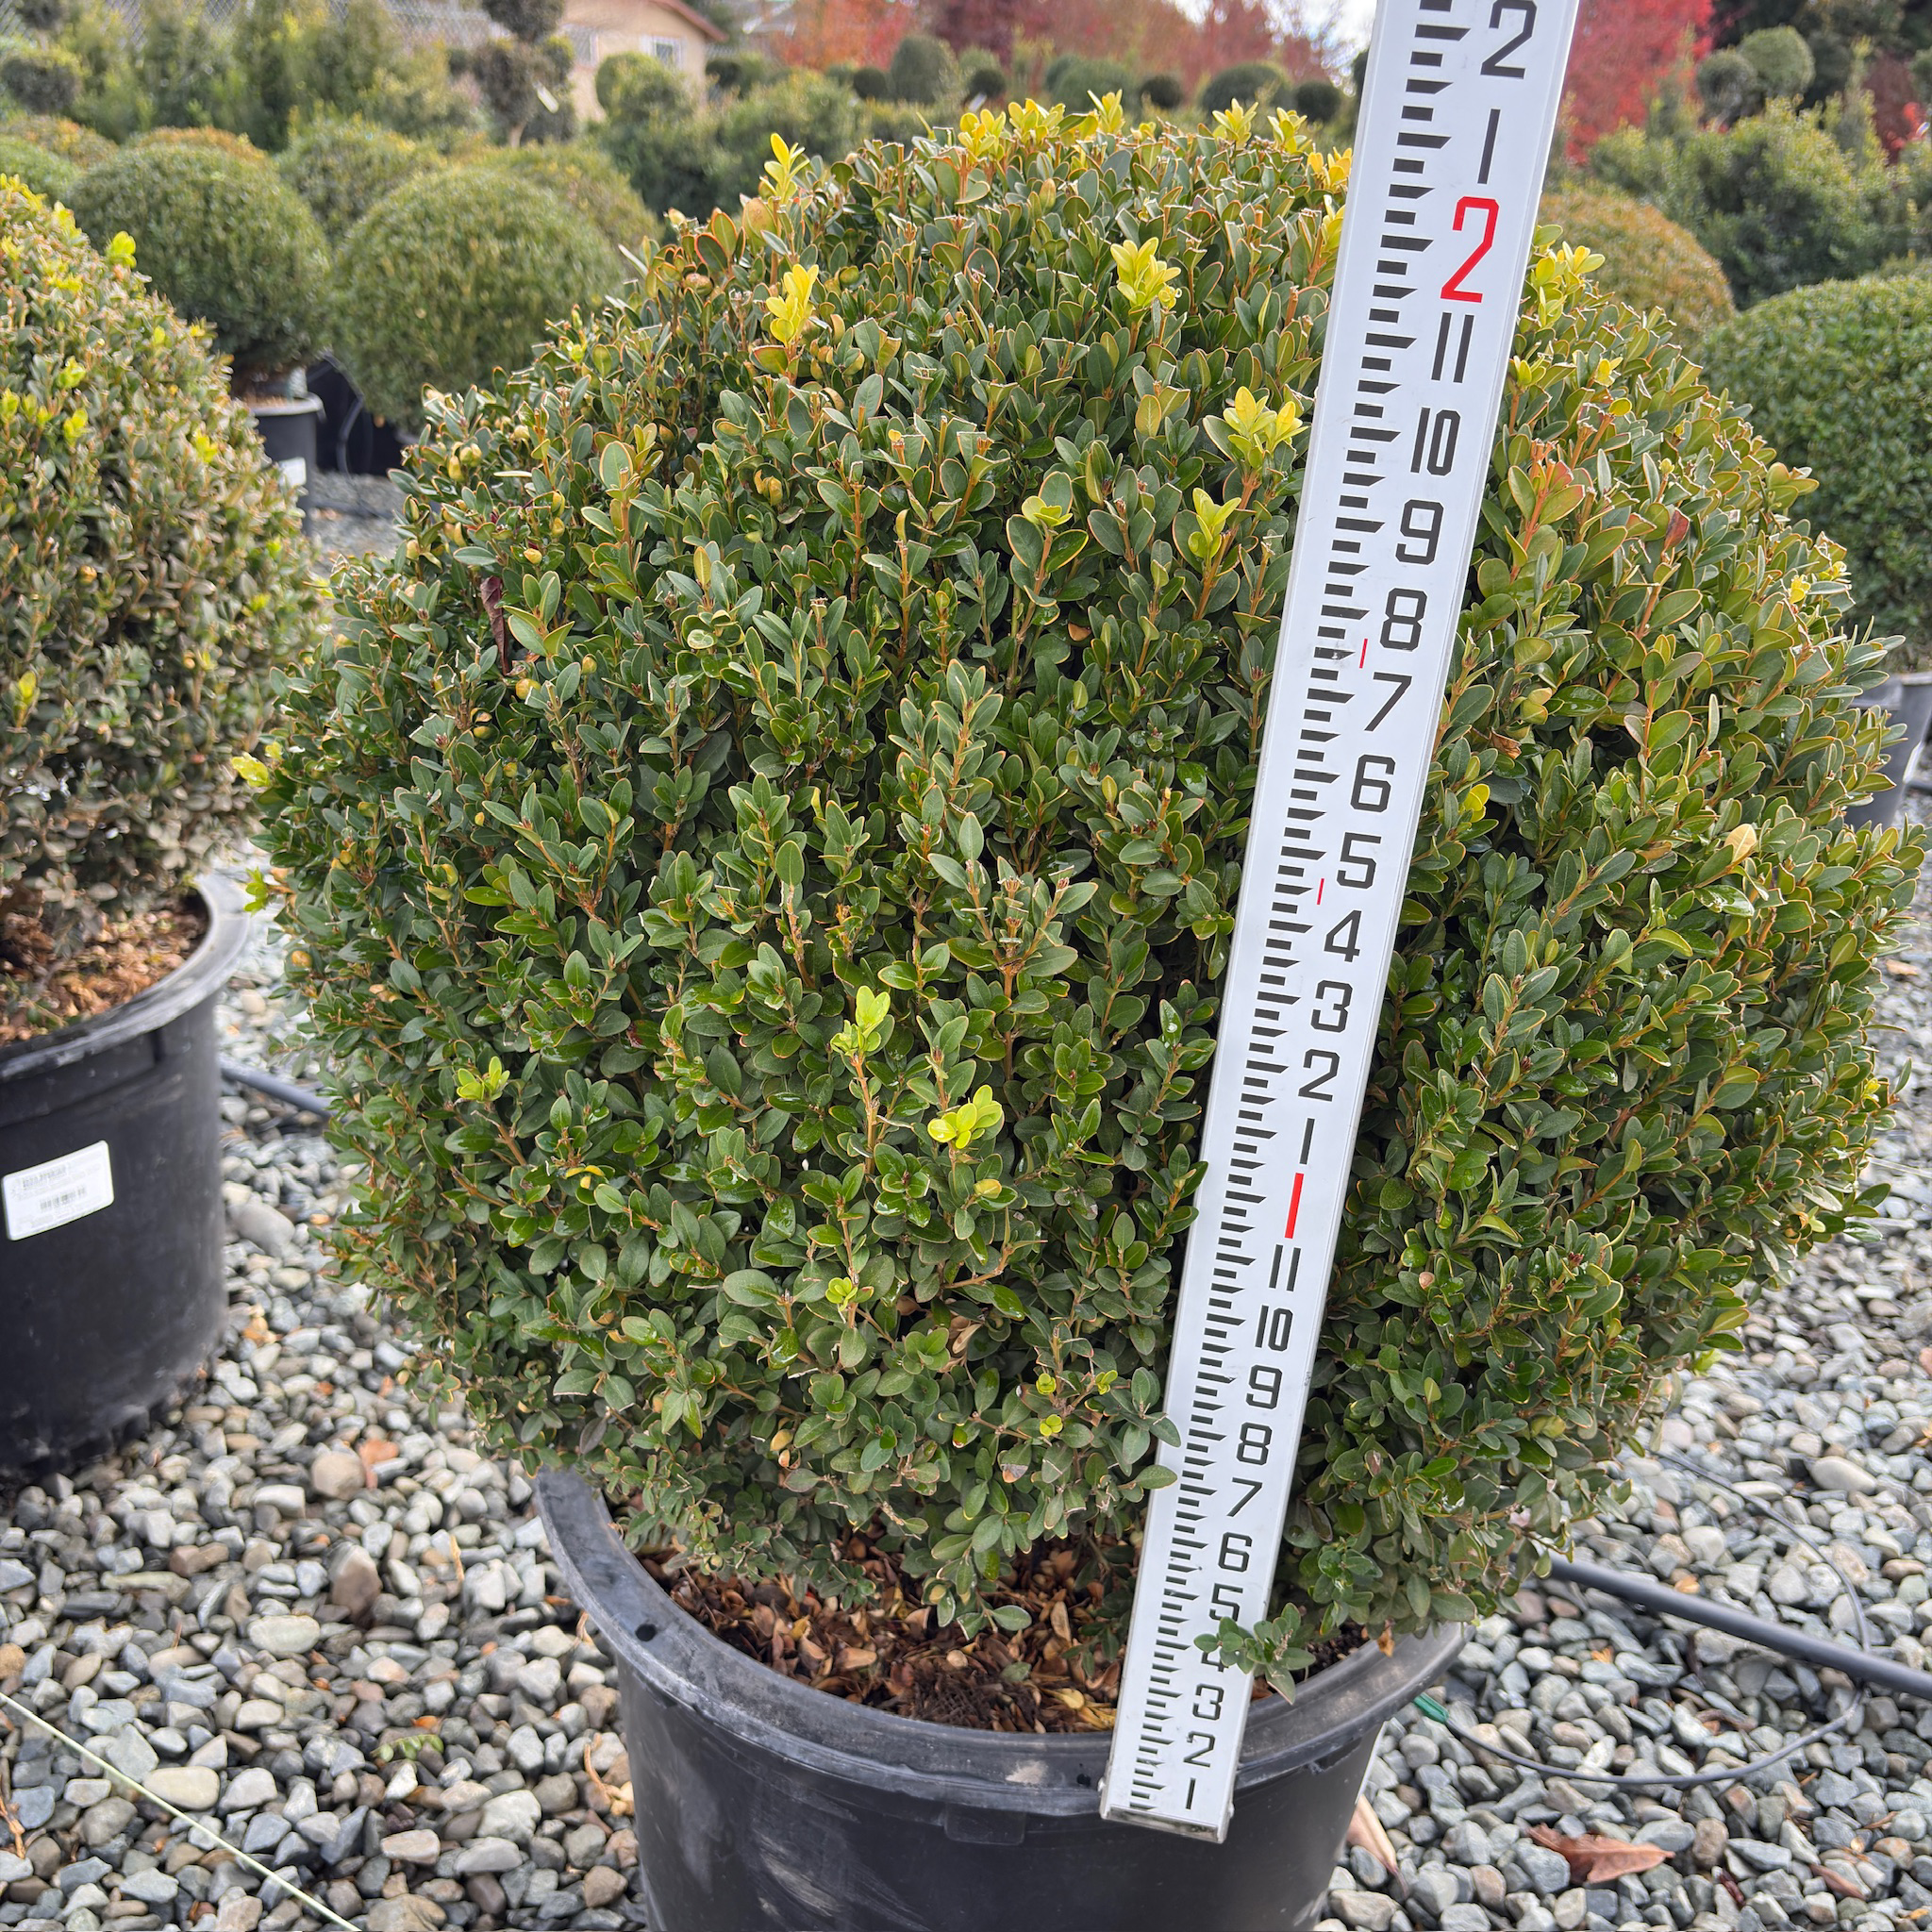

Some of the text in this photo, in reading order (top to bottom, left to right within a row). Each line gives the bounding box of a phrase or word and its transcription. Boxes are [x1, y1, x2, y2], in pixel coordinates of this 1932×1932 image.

[1481, 0, 1537, 79] 2
[1478, 108, 1500, 184] 1
[1441, 196, 1499, 303] 2
[1431, 312, 1474, 383] 11
[1411, 408, 1460, 475] 10
[1395, 500, 1444, 565] 9
[1379, 588, 1427, 651] 8
[1364, 672, 1412, 732] 7
[1350, 754, 1396, 813] 6
[1336, 832, 1382, 890] 5
[1324, 909, 1362, 963] 4
[1310, 980, 1353, 1033] 3
[1298, 1049, 1341, 1102] 2
[1300, 1118, 1315, 1165] 1
[1285, 1173, 1305, 1239] 1
[1269, 1244, 1301, 1291] 11
[1255, 1305, 1293, 1352] 10
[1245, 1364, 1282, 1409] 9
[1236, 1423, 1272, 1465] 8
[1226, 1478, 1262, 1518] 7
[1218, 1532, 1253, 1573] 6
[1208, 1583, 1244, 1623] 5
[1192, 1683, 1224, 1721] 3
[1183, 1733, 1216, 1768] 2
[1185, 1778, 1196, 1809] 1
